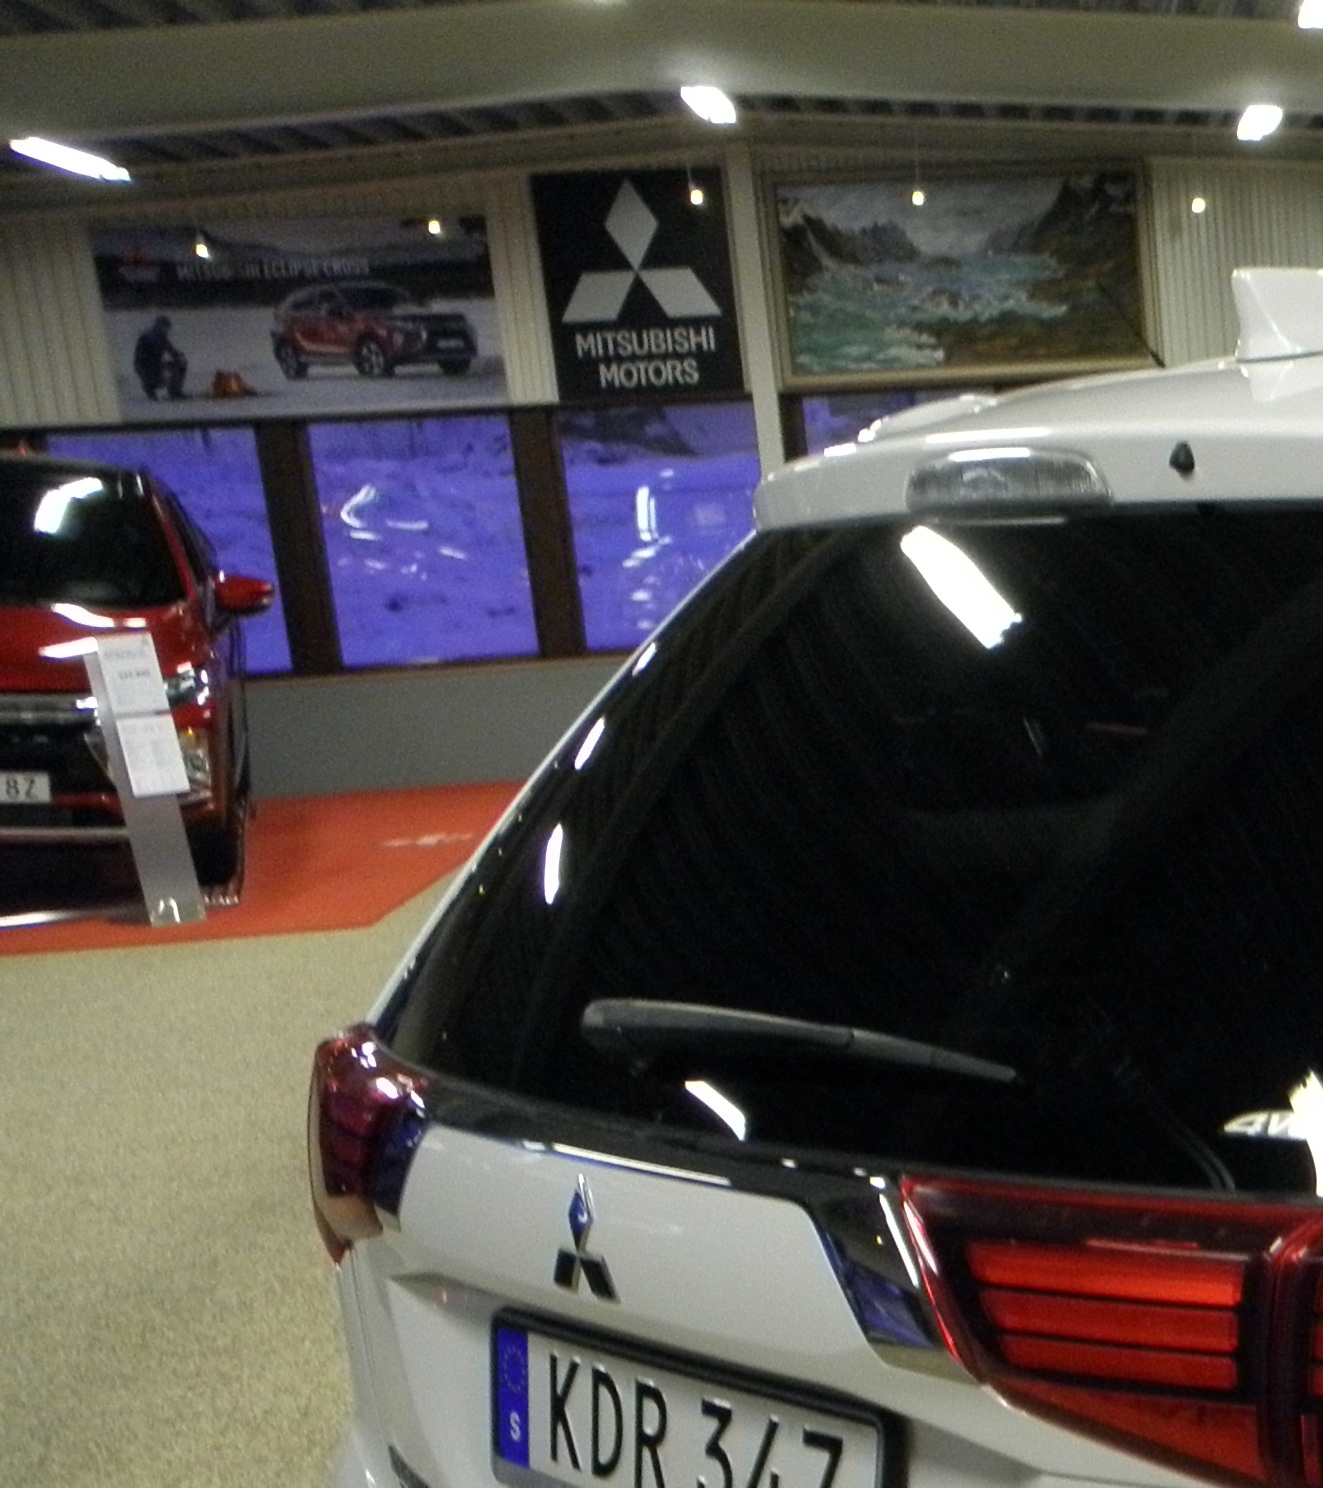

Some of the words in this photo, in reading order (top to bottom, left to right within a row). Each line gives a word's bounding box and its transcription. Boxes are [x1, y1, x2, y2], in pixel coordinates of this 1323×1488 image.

[575, 325, 716, 358] MITSUBISHI
[599, 358, 700, 388] MOTORS
[509, 1411, 521, 1441] S
